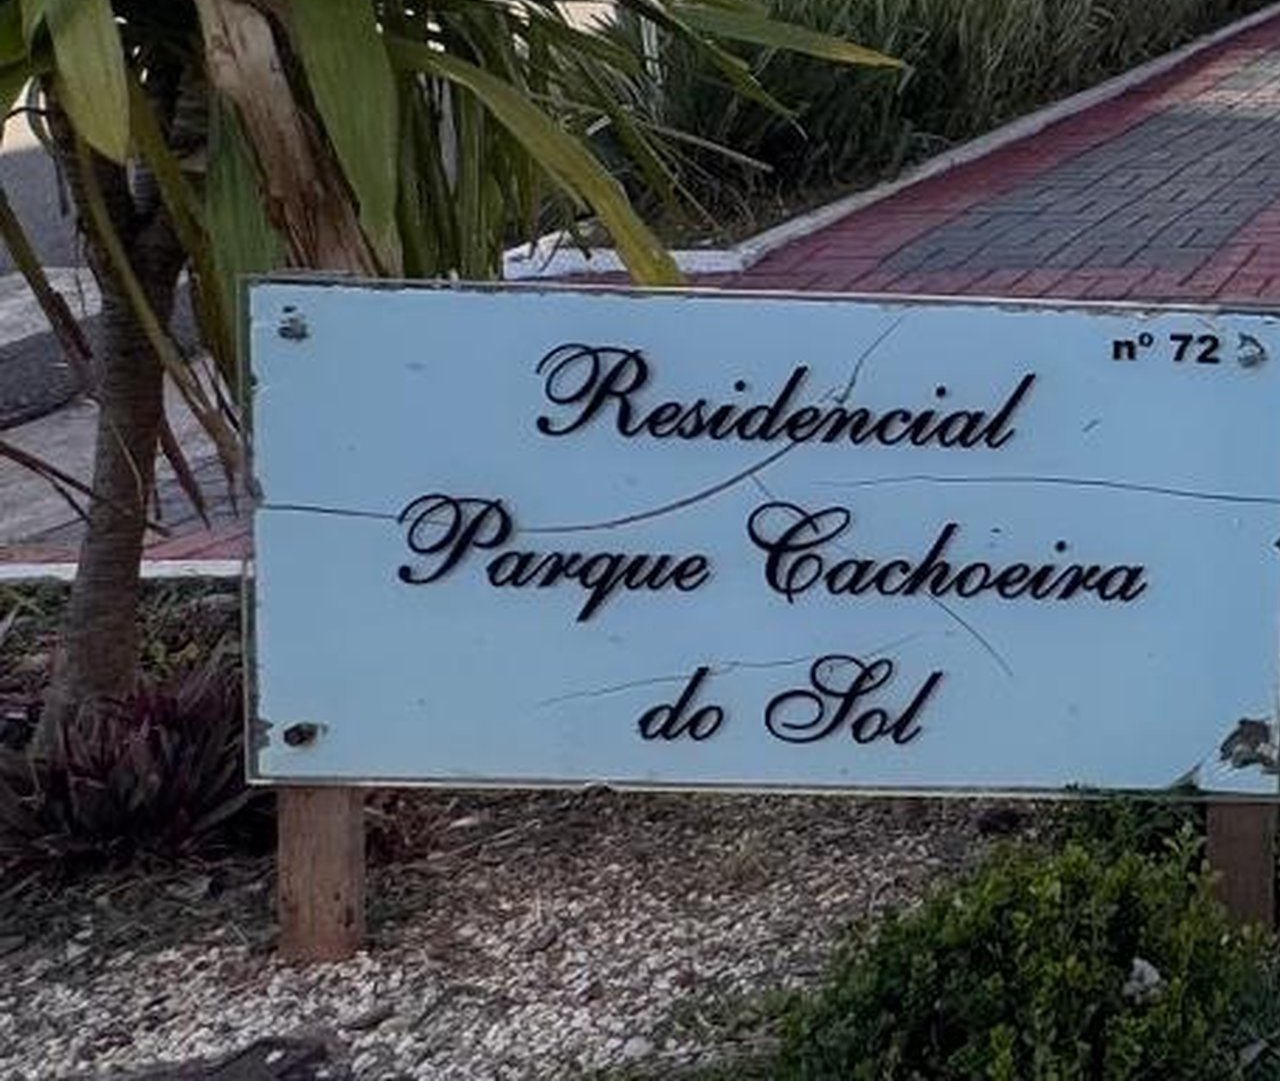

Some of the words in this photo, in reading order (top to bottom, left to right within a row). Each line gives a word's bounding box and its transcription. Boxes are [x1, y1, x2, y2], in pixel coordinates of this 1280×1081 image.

[534, 342, 1037, 452] Residencial
[1168, 332, 1222, 365] 72
[396, 492, 711, 624] Parque
[746, 500, 1149, 605] Cachoeira
[636, 665, 725, 743] do
[763, 653, 945, 746] Sol
